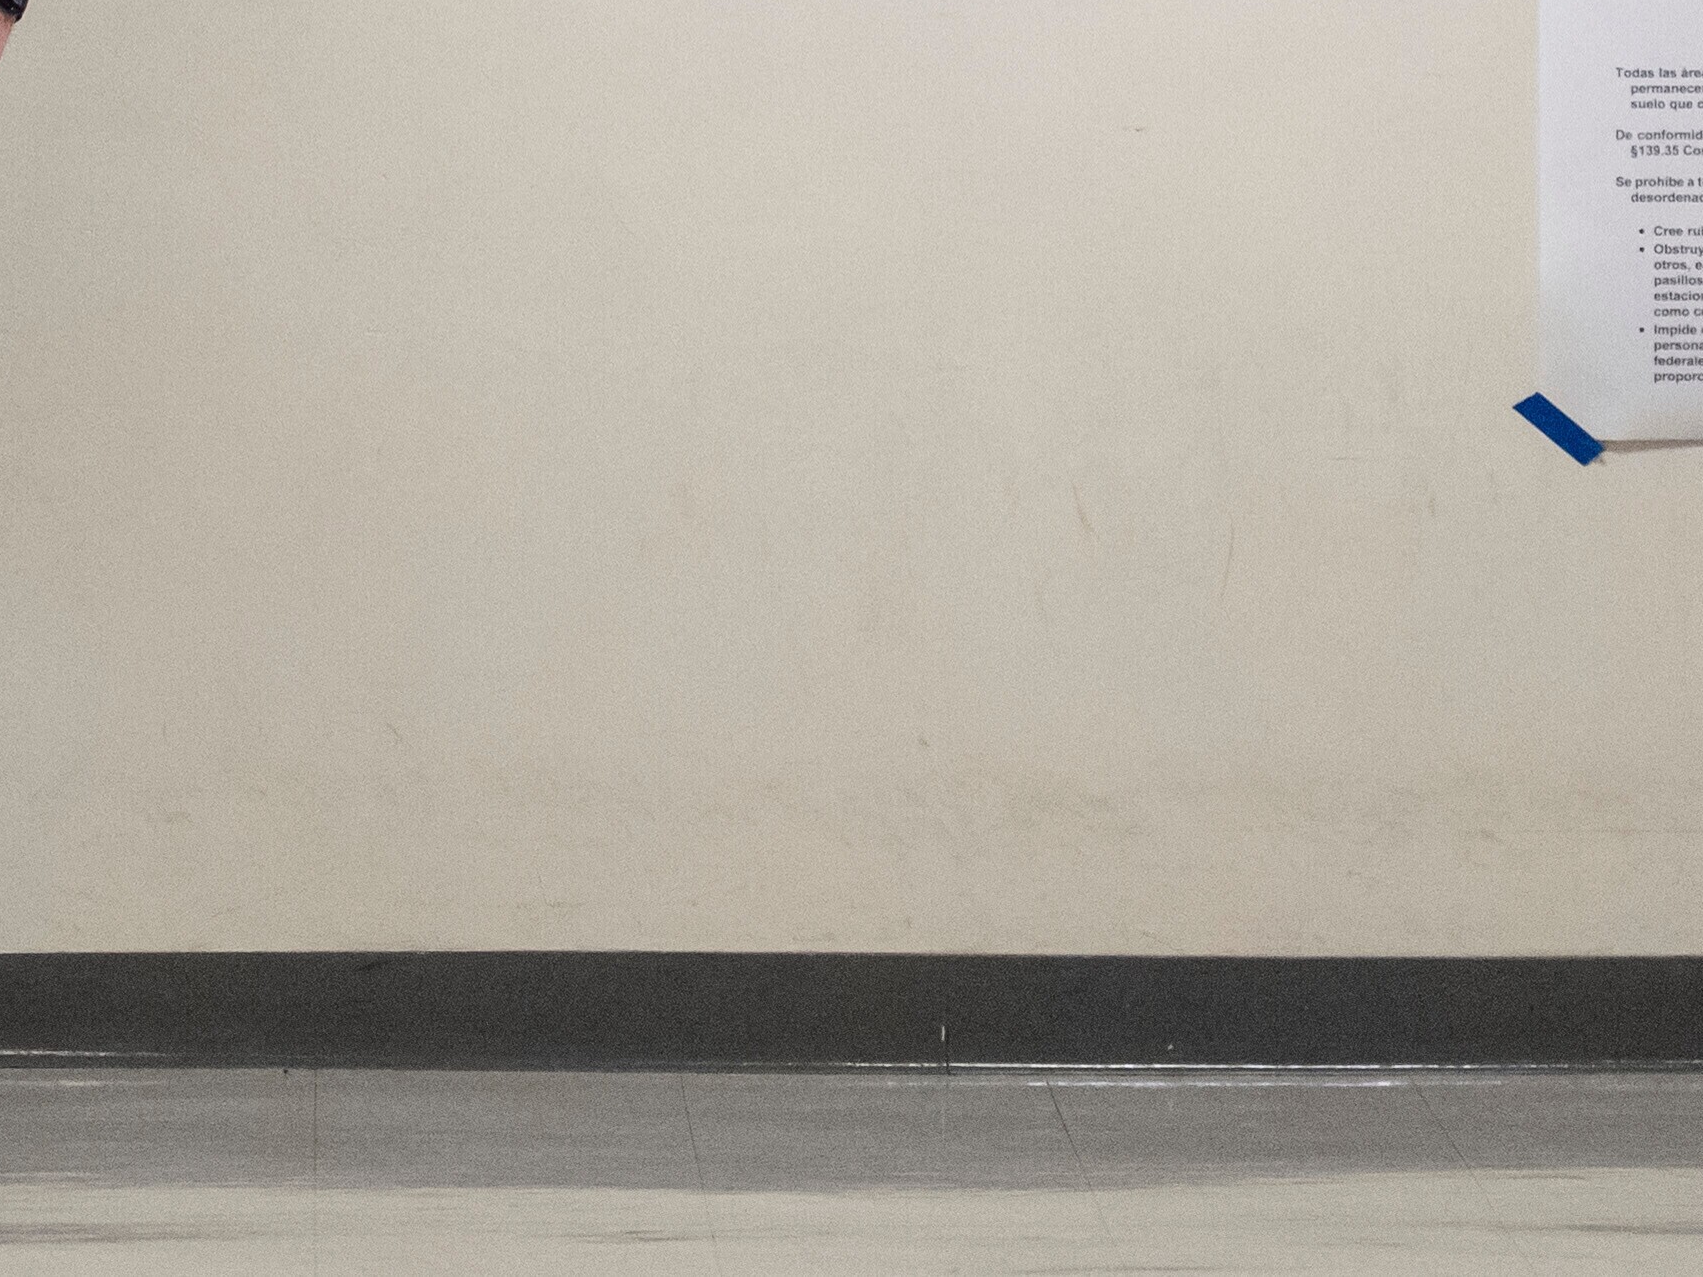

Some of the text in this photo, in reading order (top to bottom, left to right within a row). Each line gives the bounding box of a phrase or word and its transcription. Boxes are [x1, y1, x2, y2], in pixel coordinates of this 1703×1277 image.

[1616, 67, 1655, 78] Todas
[1658, 67, 1677, 78] las
[1630, 84, 1703, 96] permanece
[1630, 98, 1665, 110] suelo
[1669, 100, 1693, 111] que
[1615, 129, 1632, 141] De
[1615, 176, 1632, 187] Se
[1687, 179, 1694, 187] a
[1653, 225, 1684, 236] Cree
[1653, 290, 1703, 301] estacio
[1653, 308, 1690, 317] como
[1653, 324, 1697, 338] Impide
